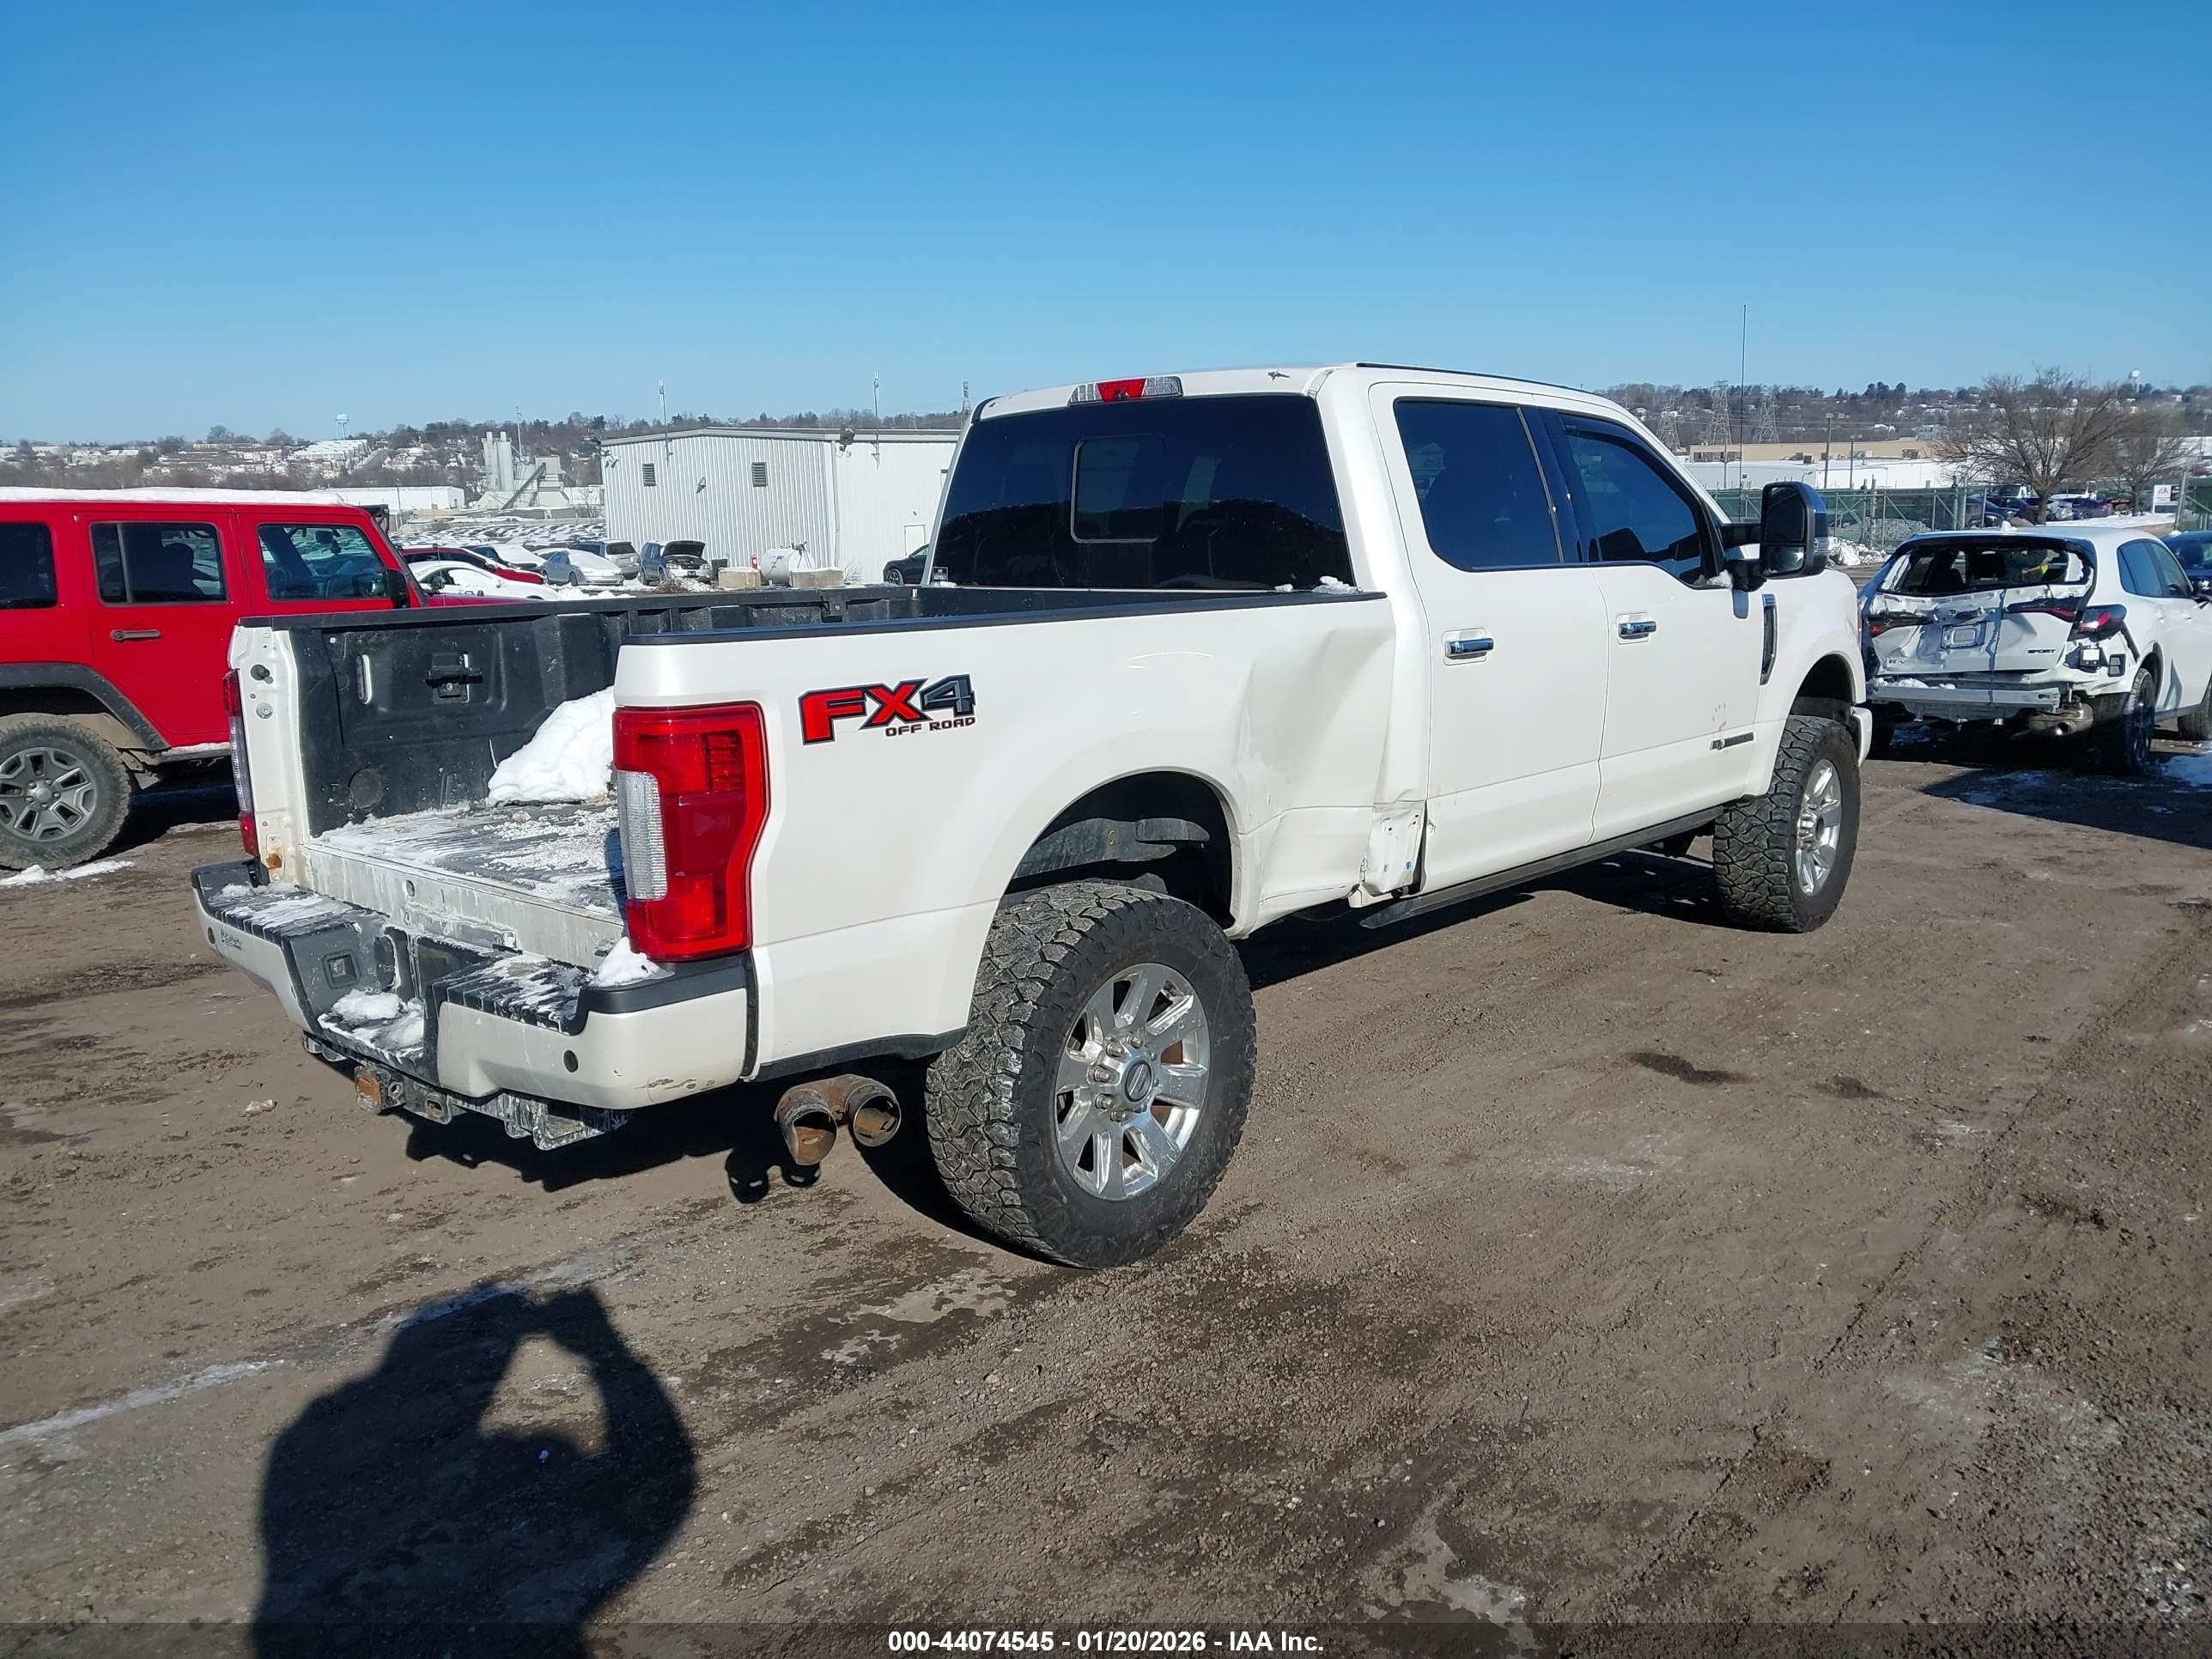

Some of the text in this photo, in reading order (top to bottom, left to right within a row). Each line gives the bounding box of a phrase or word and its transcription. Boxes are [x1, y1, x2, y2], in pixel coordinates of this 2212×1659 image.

[798, 673, 975, 745] FX4
[885, 717, 976, 737] OFF ROAD
